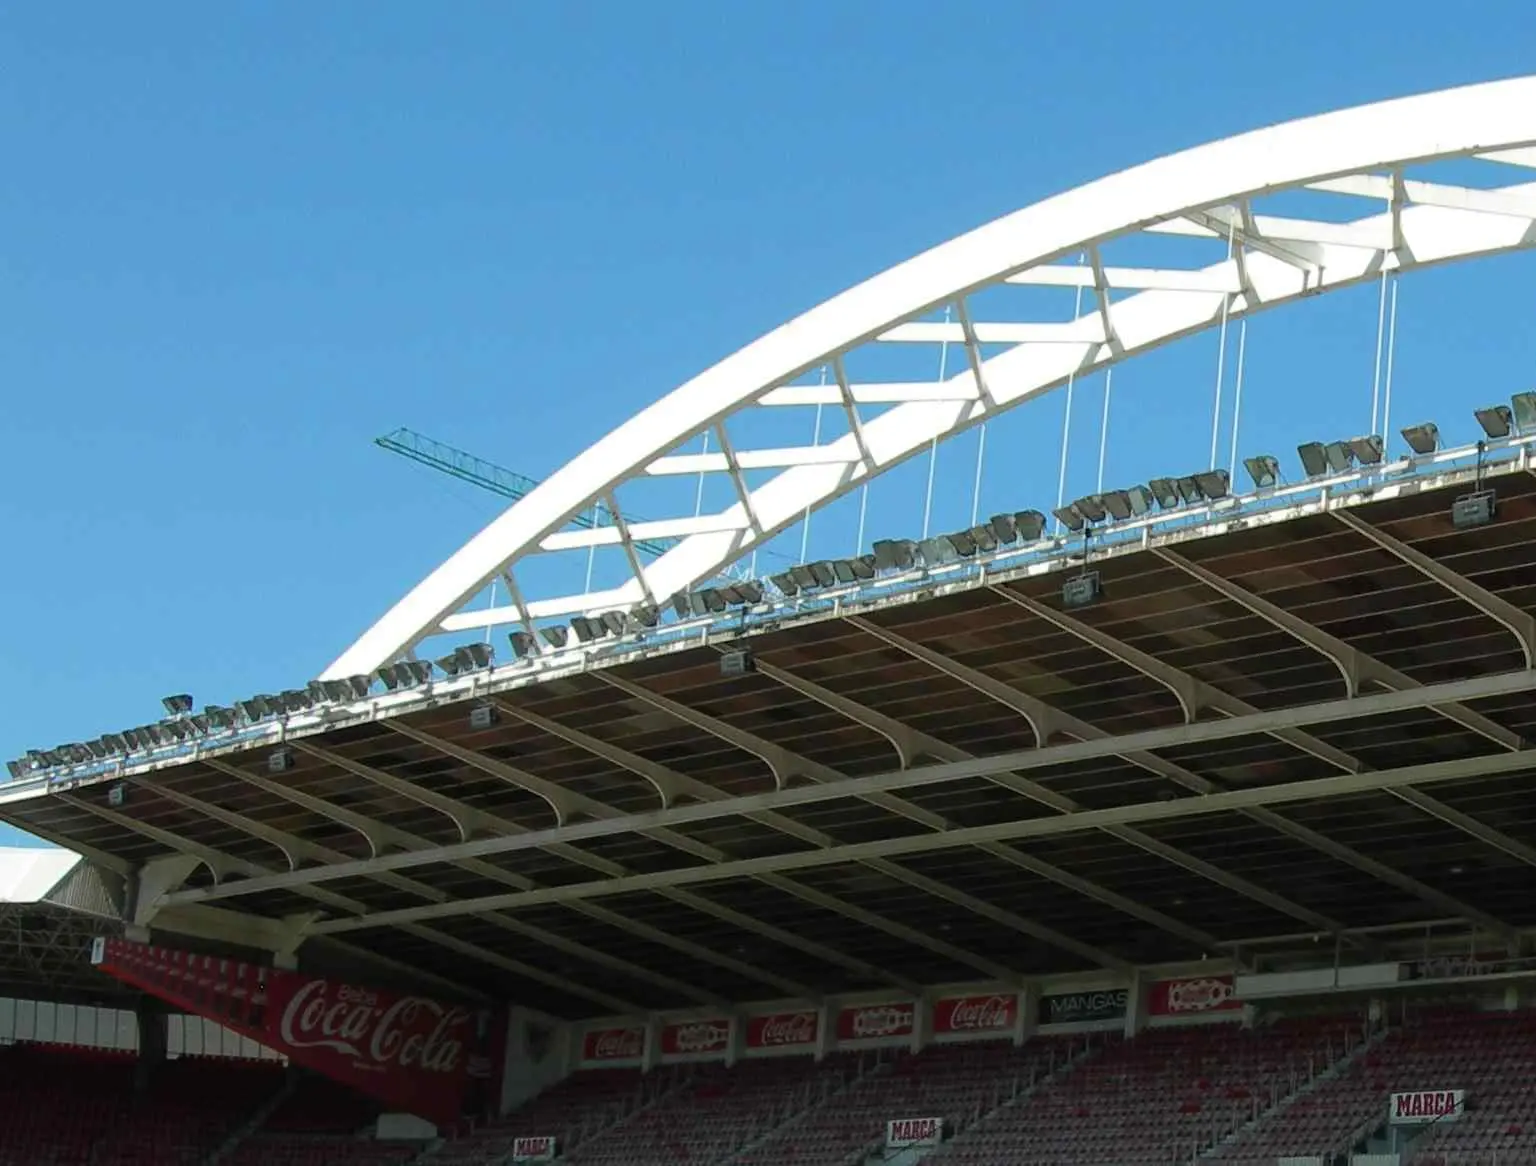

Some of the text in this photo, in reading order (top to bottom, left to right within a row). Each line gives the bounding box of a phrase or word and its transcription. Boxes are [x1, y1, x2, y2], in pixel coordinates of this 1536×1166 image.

[280, 978, 471, 1074] Coca-Cola
[1396, 1092, 1456, 1117] MARCA
[891, 1119, 936, 1141] MARCA
